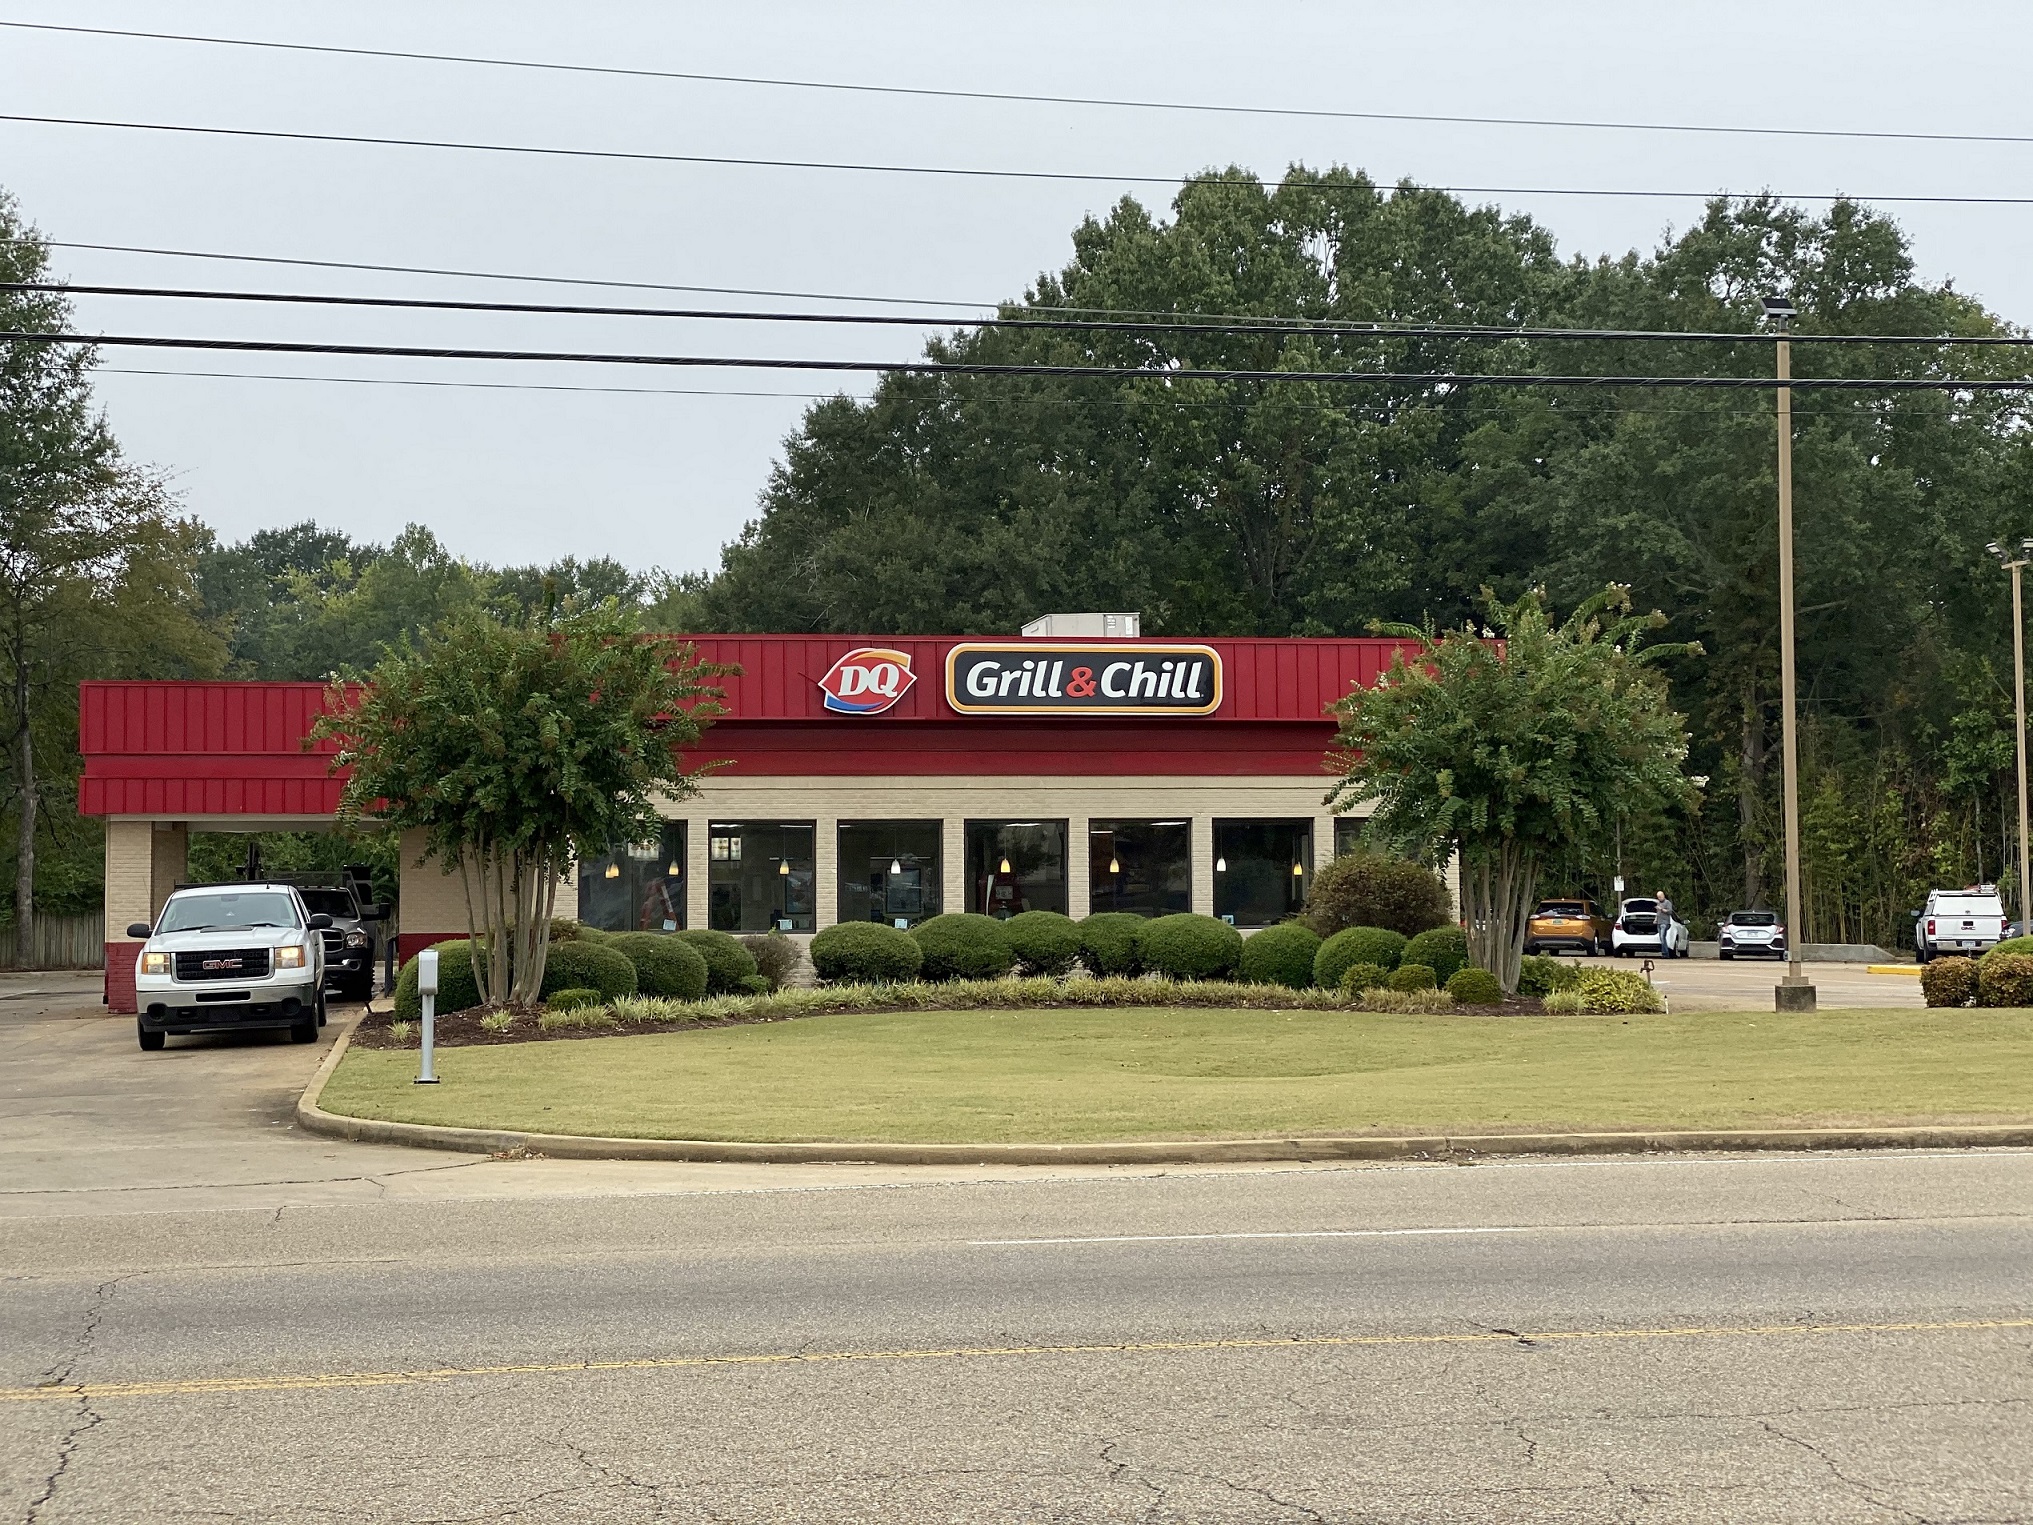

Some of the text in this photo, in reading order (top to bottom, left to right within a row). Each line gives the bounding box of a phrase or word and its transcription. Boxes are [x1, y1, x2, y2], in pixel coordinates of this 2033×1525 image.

[838, 663, 899, 698] DQ
[966, 660, 1202, 698] Grill & Chill
[203, 958, 243, 970] GMC
